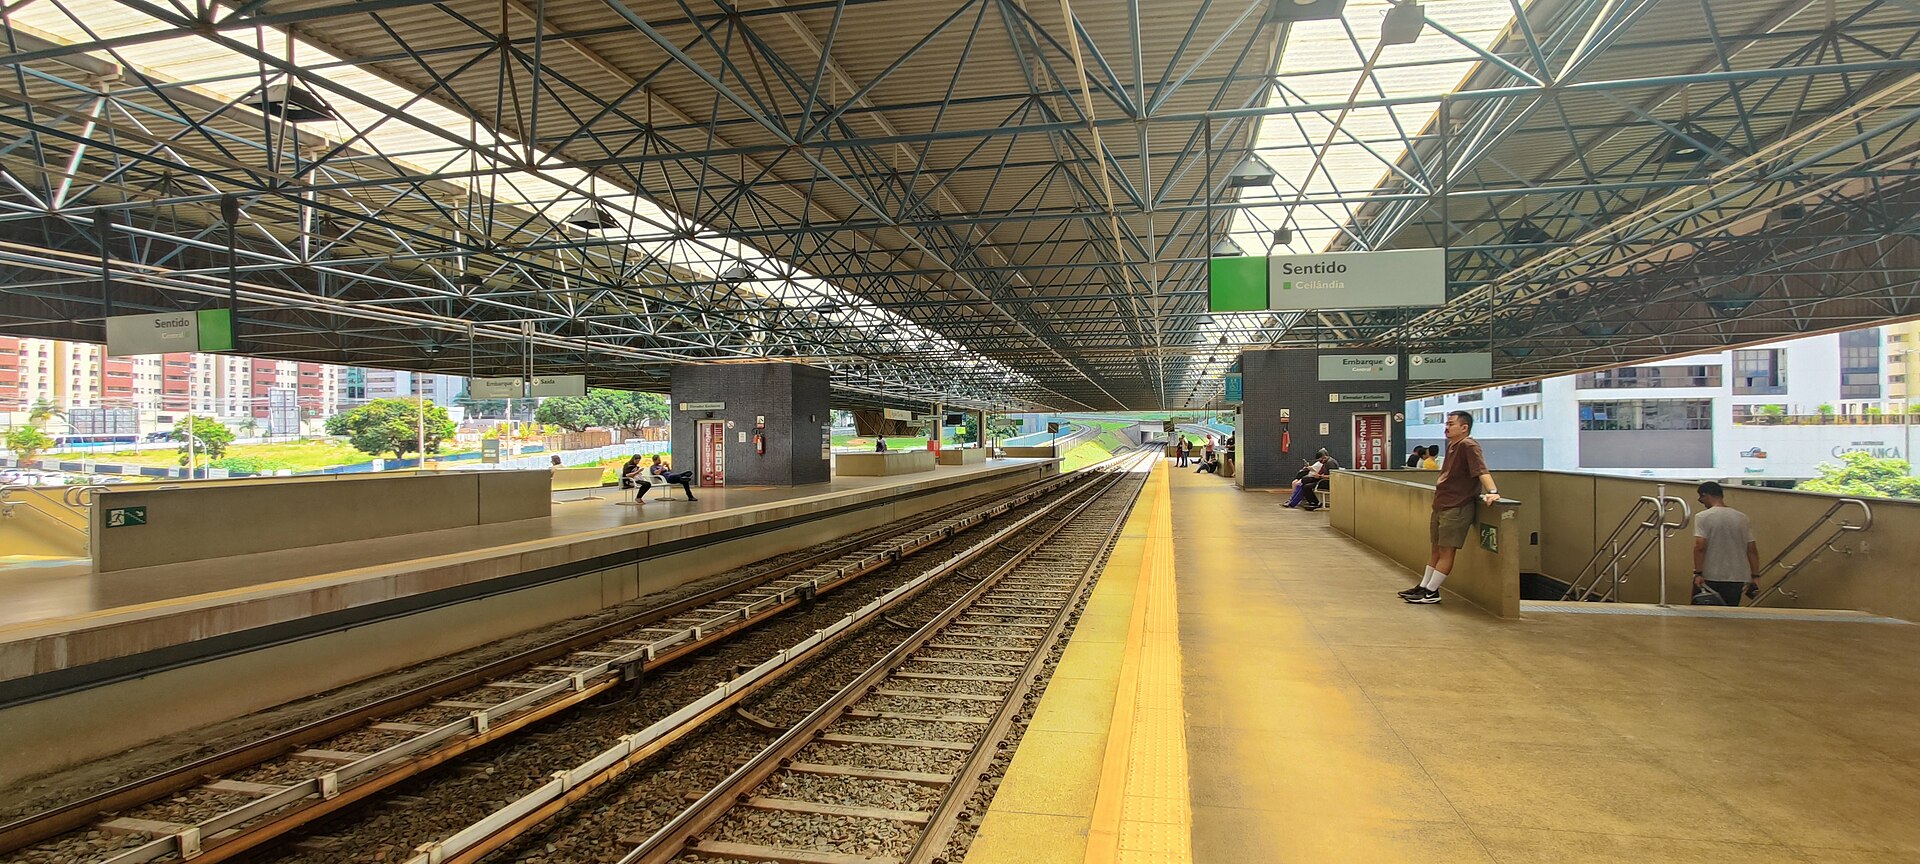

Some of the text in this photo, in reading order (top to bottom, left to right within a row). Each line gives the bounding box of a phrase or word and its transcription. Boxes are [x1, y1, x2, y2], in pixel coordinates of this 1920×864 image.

[1283, 261, 1347, 275] Sentido
[1295, 280, 1345, 290] Ceilândia
[154, 318, 190, 328] Sentido
[1342, 358, 1383, 366] Embarque
[1424, 356, 1446, 364] Saída
